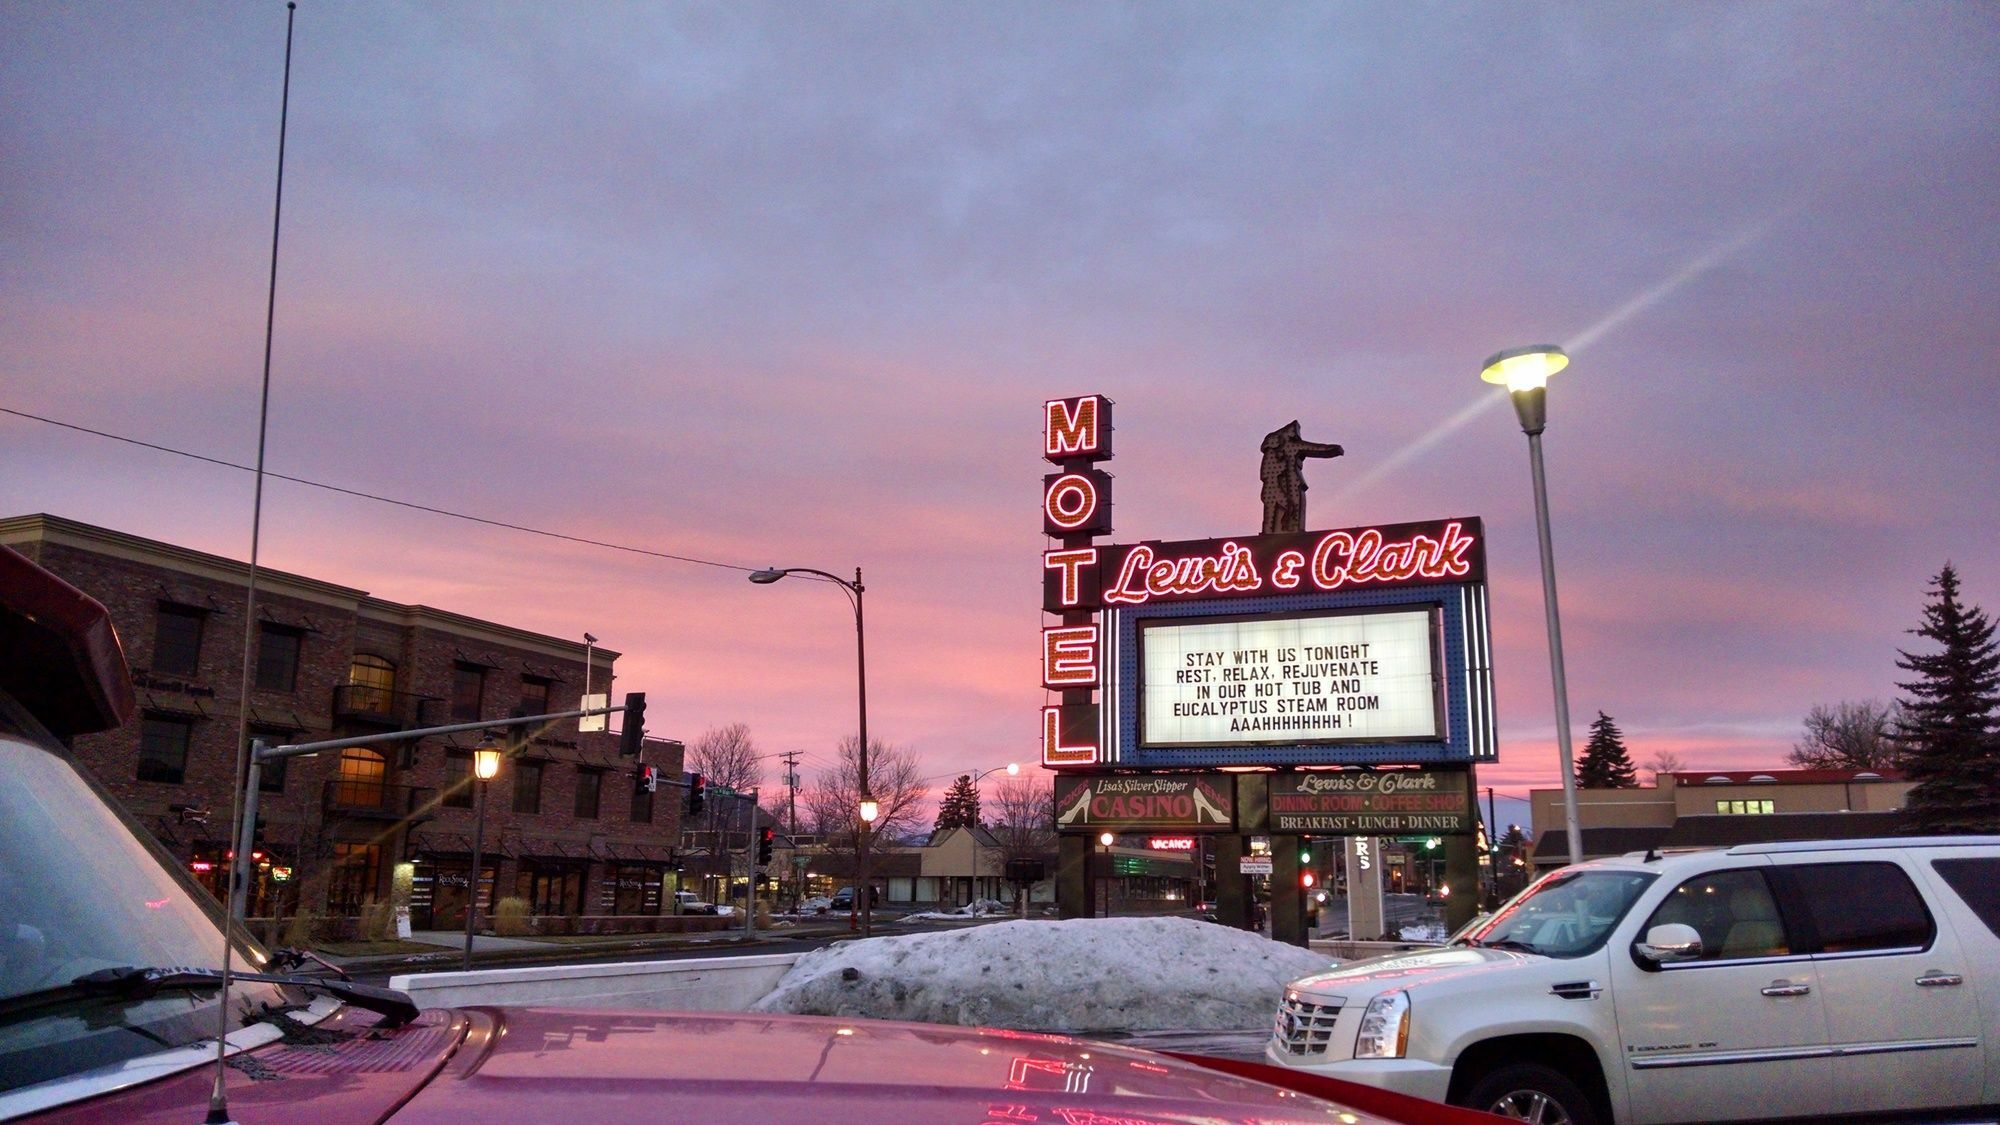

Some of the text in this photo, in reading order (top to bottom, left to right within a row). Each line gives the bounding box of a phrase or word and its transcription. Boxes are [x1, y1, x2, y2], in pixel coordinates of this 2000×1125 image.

[1105, 522, 1474, 604] Lewis & Clark
[1043, 396, 1097, 766] MOTEL
[1186, 644, 1370, 667] STAY WITH US TONIGHT
[1176, 661, 1379, 683] REST, RELAX, REJUVENATE
[1196, 679, 1361, 700] IN OUR HOT TUB AND
[1174, 696, 1379, 716] EUCALYPTUS STEAM ROOM
[1230, 714, 1341, 732] AAAHHHHHHHH
[1096, 779, 1188, 794] Lisa's Silver Slipper
[1297, 772, 1436, 794] Lewis & Clark
[1091, 795, 1193, 818] CASINO
[1272, 795, 1465, 812] DINING ROOM COFFEE SHOP
[1280, 816, 1460, 829] BREAKFAST LUNCH DINNER
[1151, 839, 1192, 849] VACANCY
